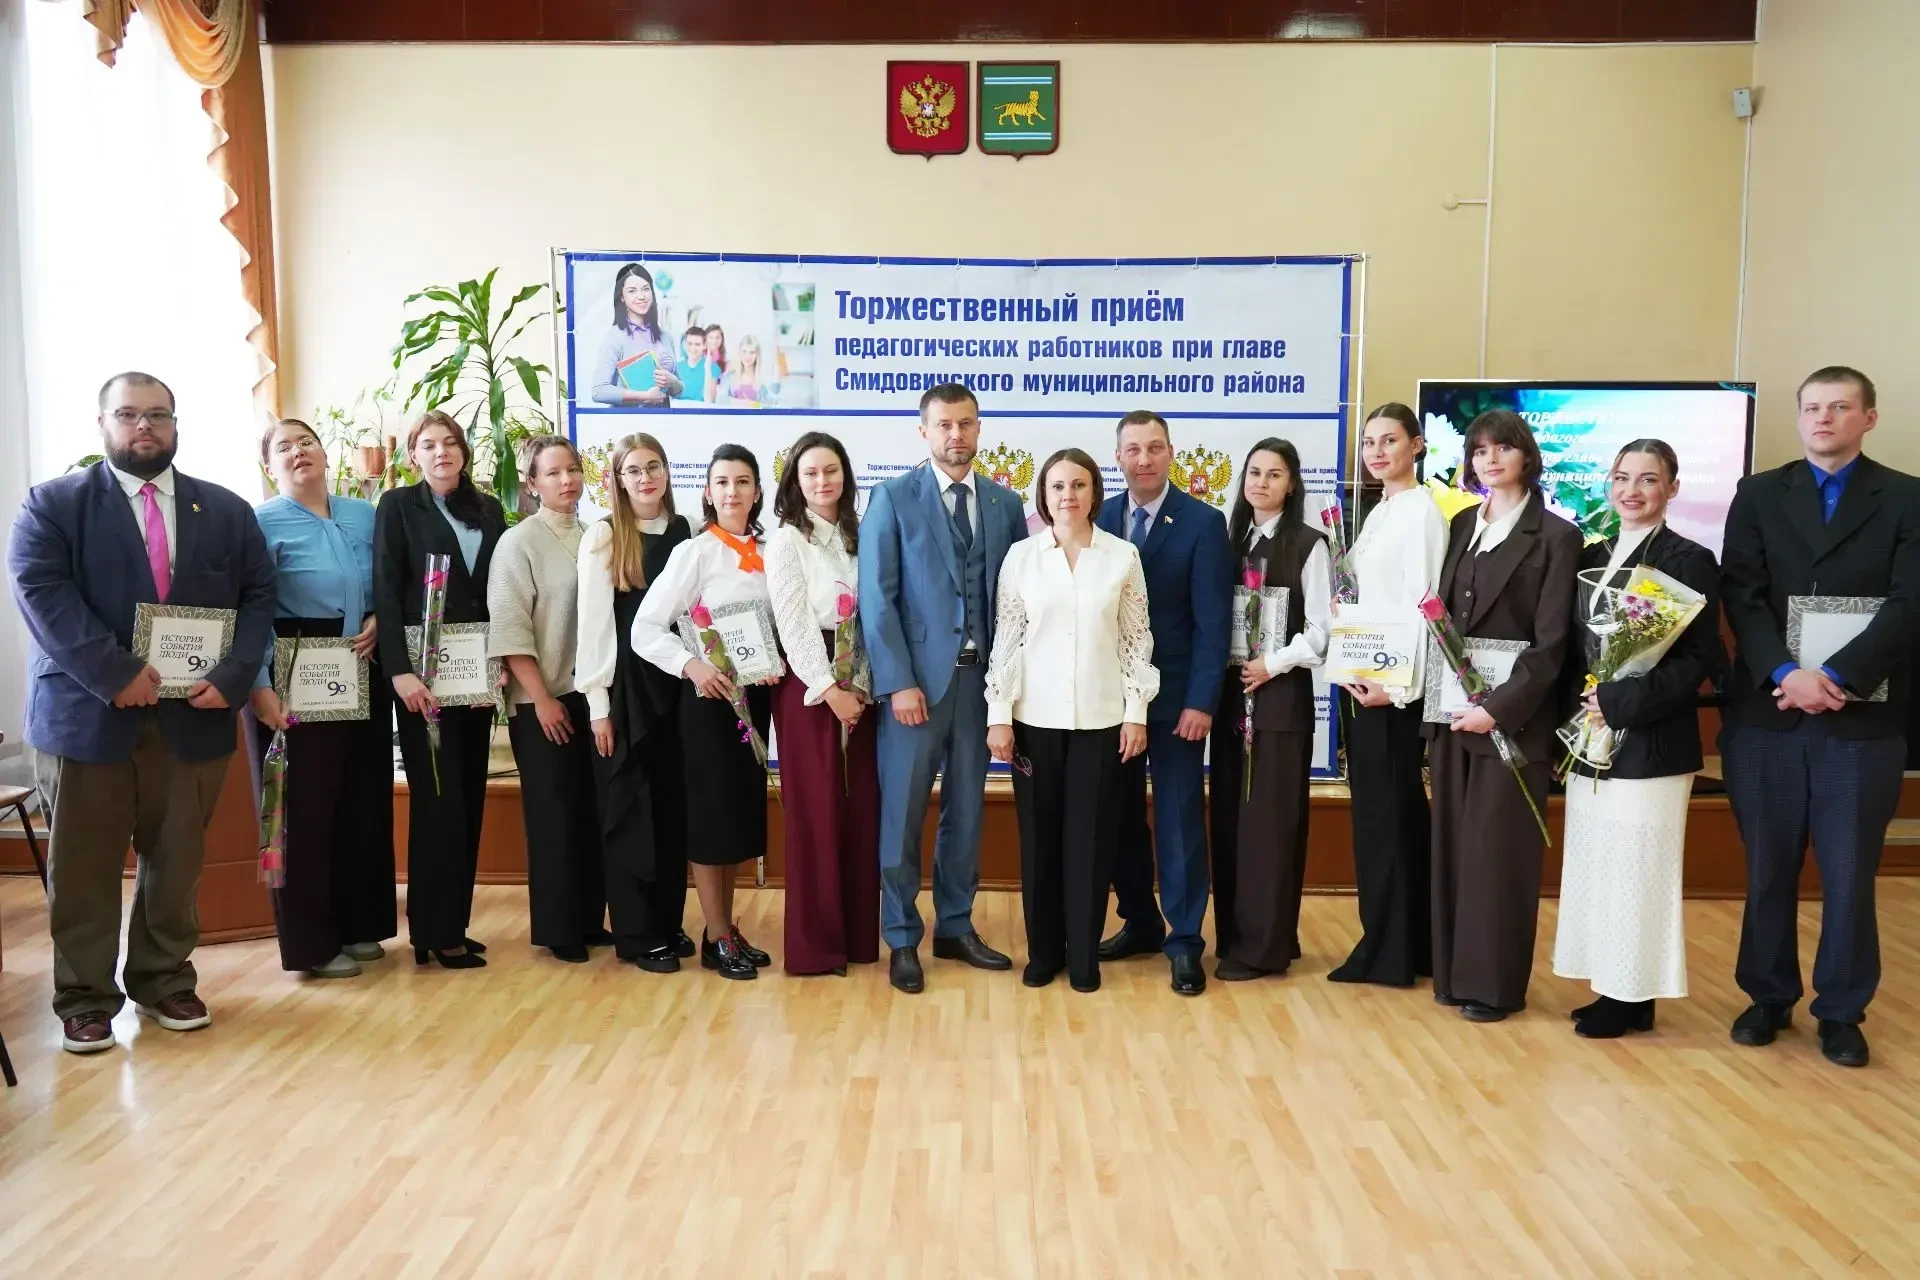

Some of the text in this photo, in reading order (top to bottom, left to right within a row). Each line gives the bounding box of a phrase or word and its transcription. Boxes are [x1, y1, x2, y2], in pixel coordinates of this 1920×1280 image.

[834, 289, 1184, 327] Торжественный приём
[835, 336, 1286, 362] педагогических работников при главе
[1023, 373, 1214, 396] муниципального
[1223, 370, 1306, 397] района
[160, 634, 204, 644] ИСТОРИЯ
[1343, 633, 1385, 641] ИСТОРИЯ
[160, 642, 204, 651] СОБЫТИЯ
[1342, 642, 1386, 650] СОБЫТИЯ
[158, 650, 189, 659] ЛЮДИ
[736, 645, 756, 662] 90
[1341, 651, 1369, 659] ЛЮДИ
[187, 655, 208, 672] 90
[450, 657, 477, 666] ЛЮДИ
[1373, 651, 1398, 672] 90
[299, 663, 340, 671] ИСТОРИЯ
[437, 665, 478, 673] СОБЫТИЯ
[439, 672, 478, 681] ИСТОРИЯ
[298, 678, 327, 686] ЛЮДИ
[327, 681, 347, 697] 90
